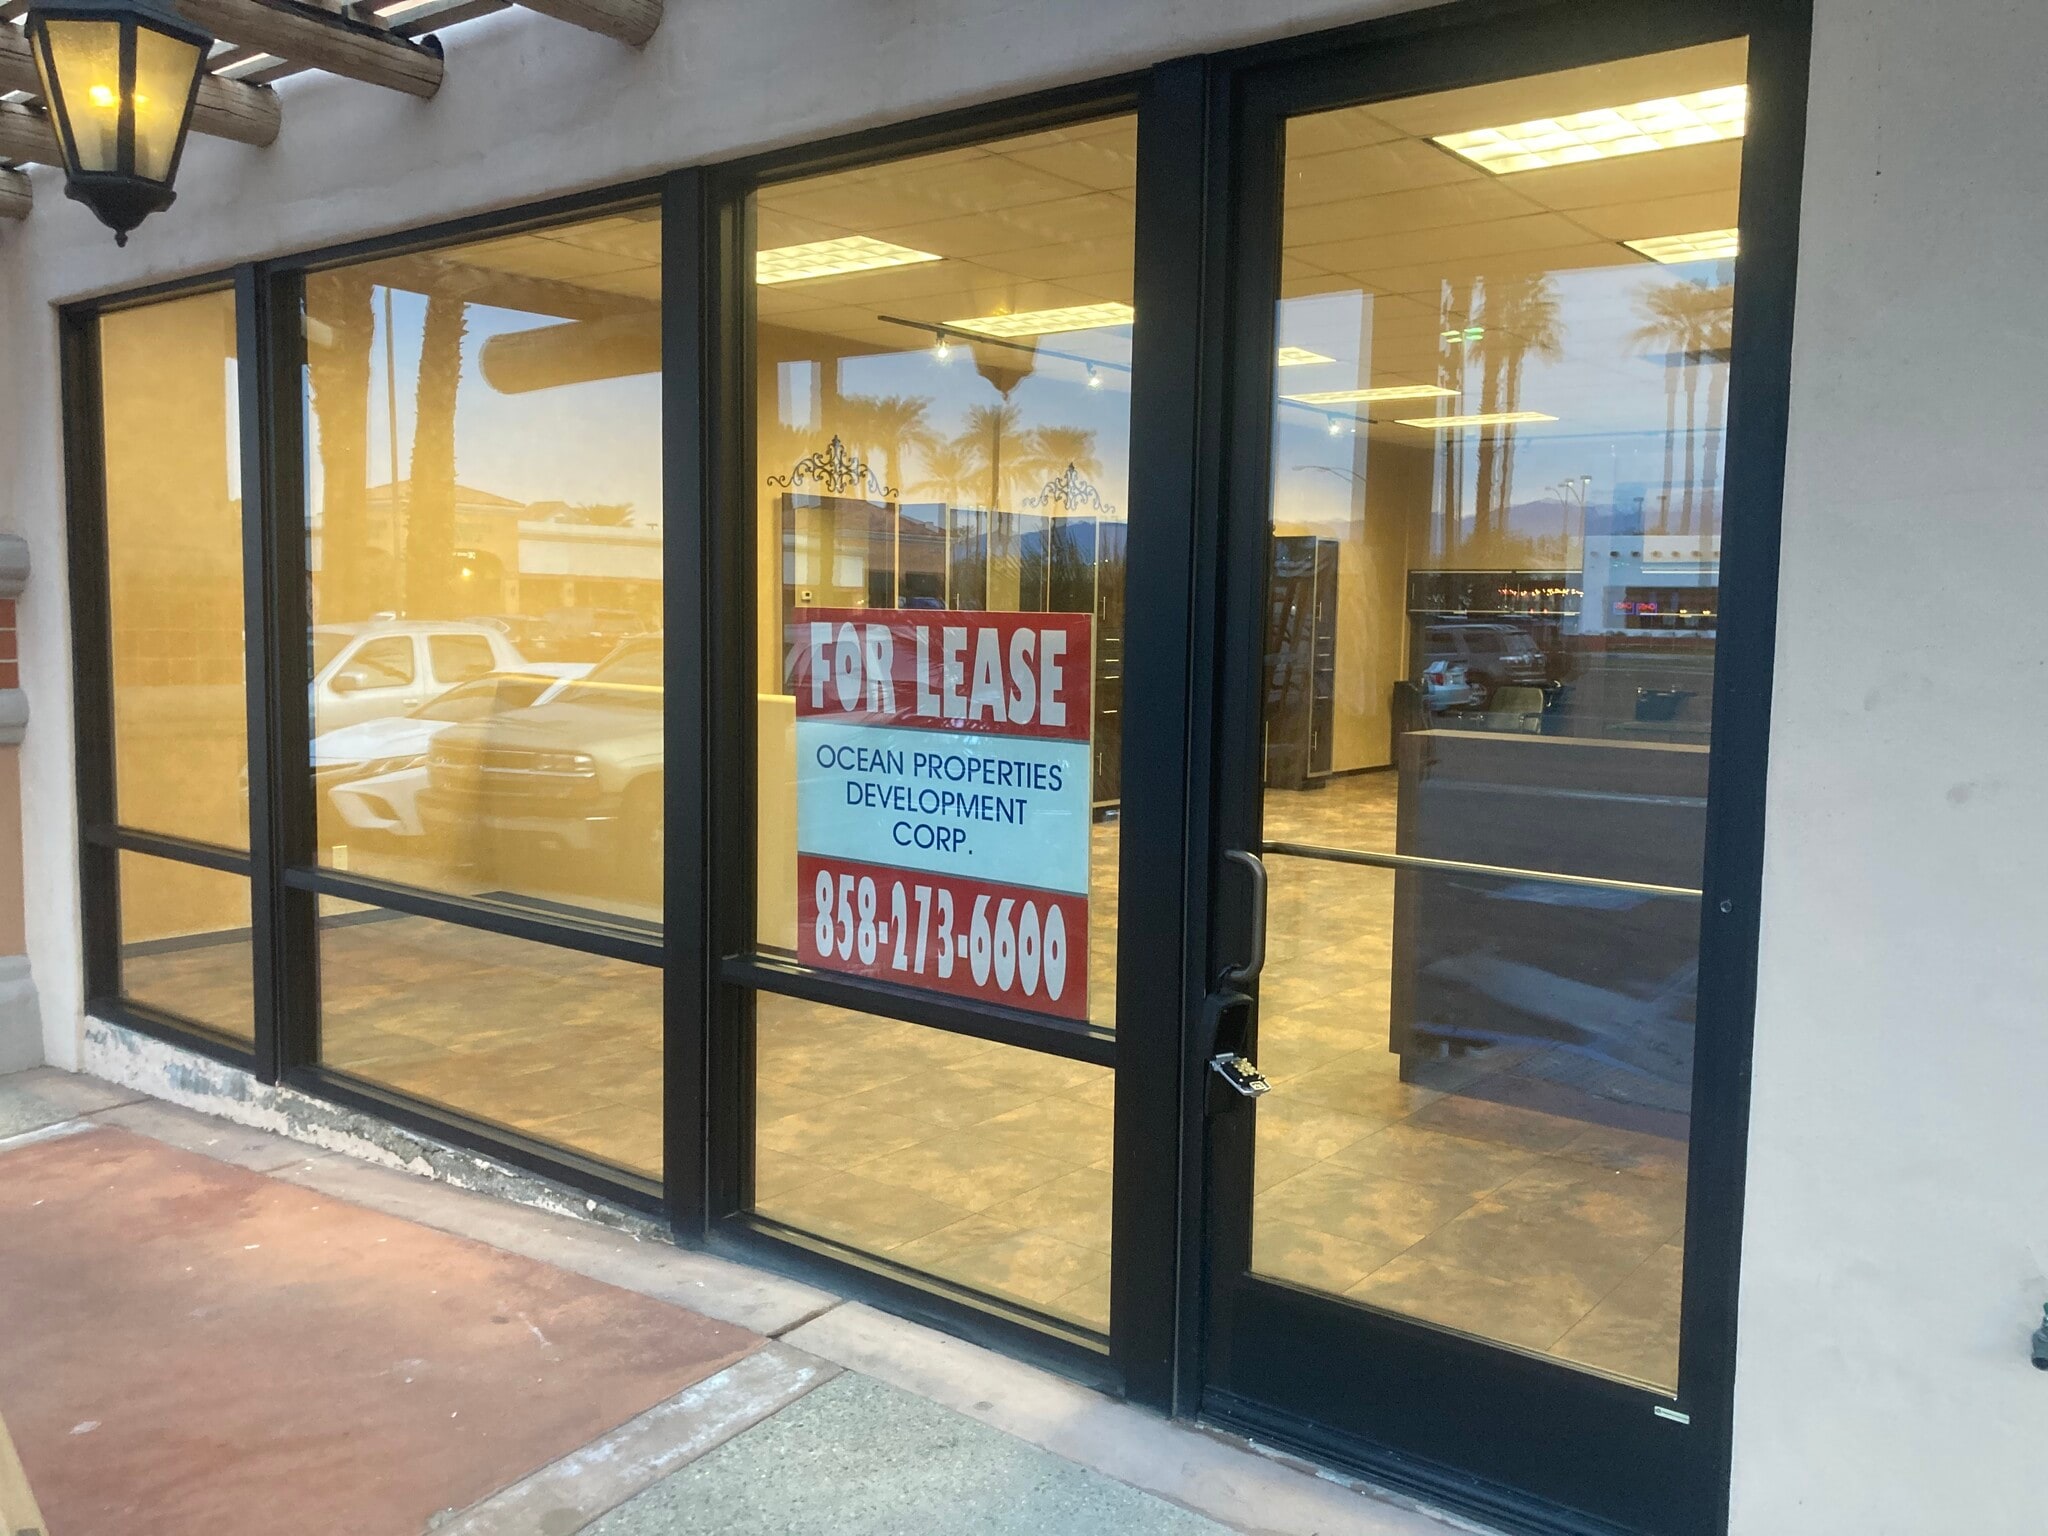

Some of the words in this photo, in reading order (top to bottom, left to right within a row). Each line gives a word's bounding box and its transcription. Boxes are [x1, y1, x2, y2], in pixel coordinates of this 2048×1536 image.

[810, 621, 896, 714] FOR
[916, 625, 1067, 727] LEASE
[816, 744, 904, 775] OCEAN
[913, 752, 1063, 792] PROPERTIES
[846, 781, 1028, 825] DEVELOPMENT
[892, 821, 974, 855] CORP.
[815, 869, 1067, 1001] 858-273-6600
